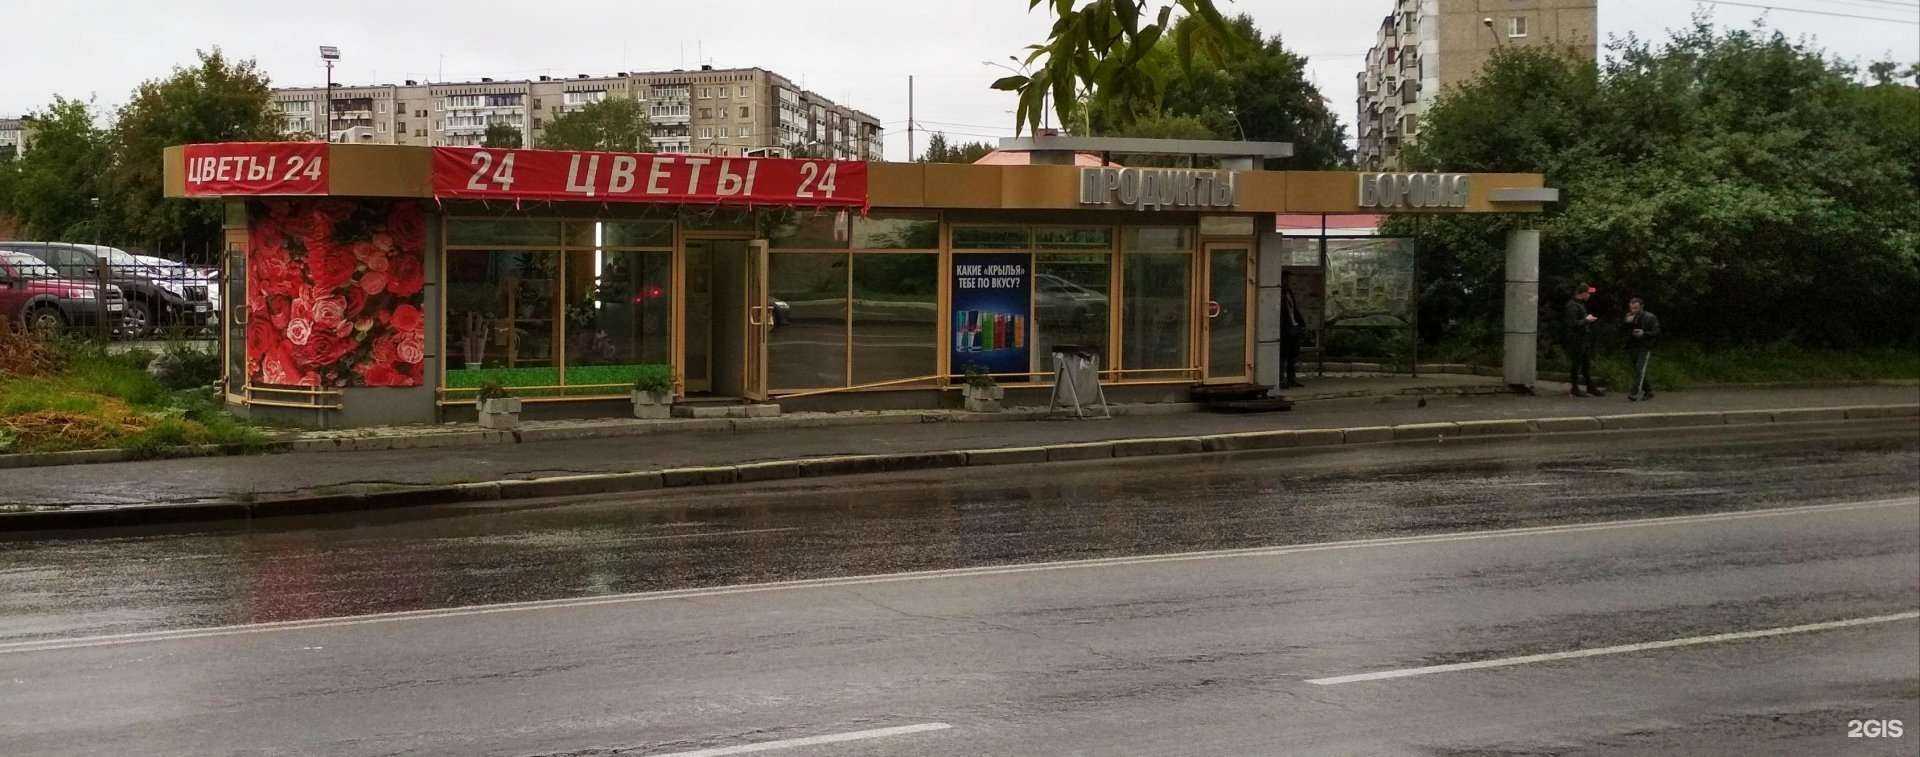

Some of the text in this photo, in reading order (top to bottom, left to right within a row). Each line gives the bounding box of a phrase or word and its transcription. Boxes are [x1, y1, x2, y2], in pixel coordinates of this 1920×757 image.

[188, 156, 323, 184] ЦВЕТЫ 24
[467, 151, 838, 198] 24 ЦВЕТЫ 24
[1080, 168, 1240, 212] ПРОДУКТЫ
[1358, 173, 1470, 208] БОРОВАЯ
[957, 265, 1025, 276] КАКИЕ «КРЫЛЬЯ»
[959, 278, 1021, 289] ТЕБЕ ПО ВКУСУ?
